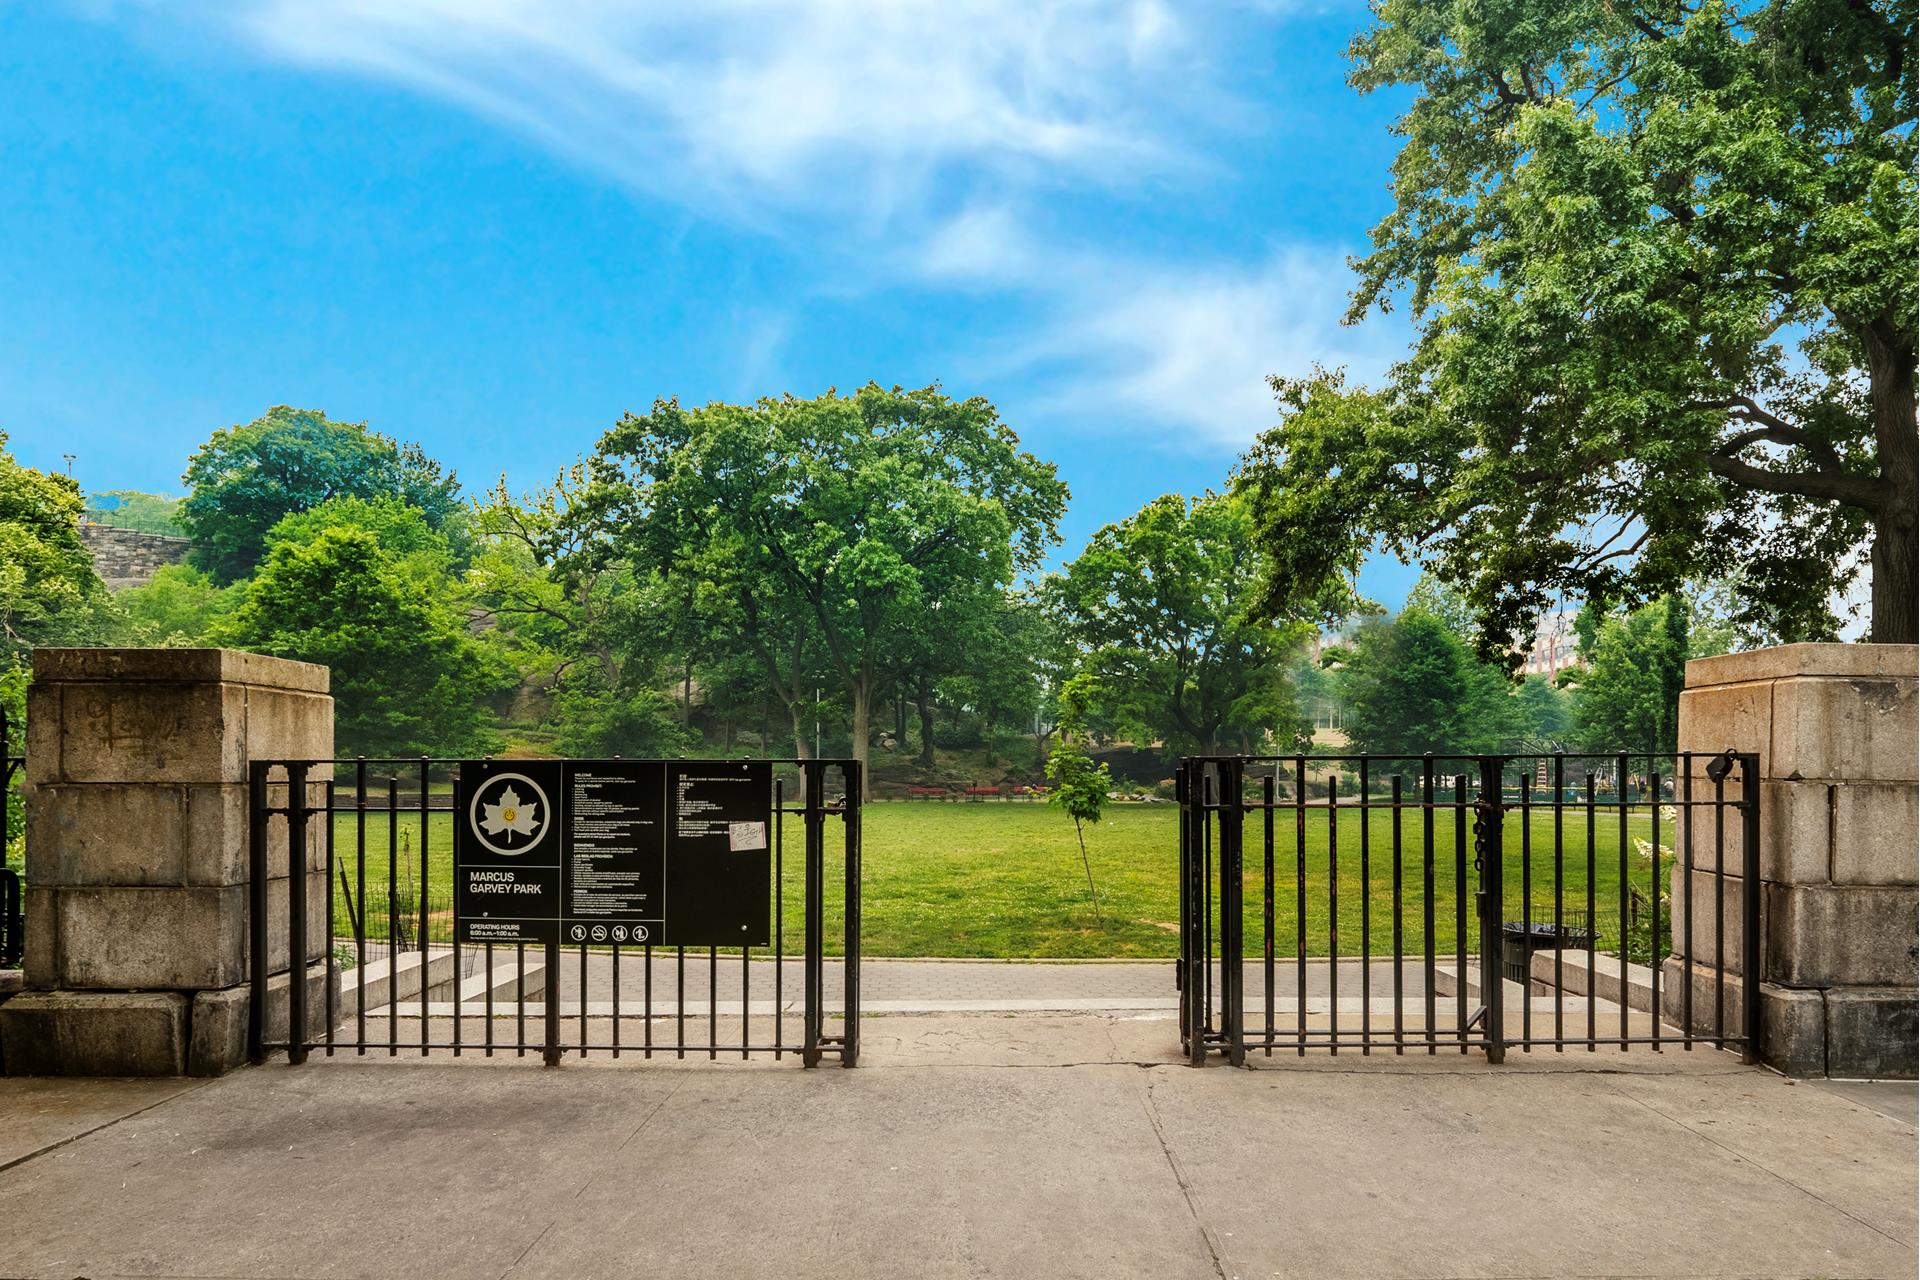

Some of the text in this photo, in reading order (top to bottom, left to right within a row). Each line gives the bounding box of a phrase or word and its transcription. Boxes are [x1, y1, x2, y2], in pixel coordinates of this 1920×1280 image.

[470, 872, 515, 882] MARCUS
[470, 883, 542, 894] GARVEY PARK
